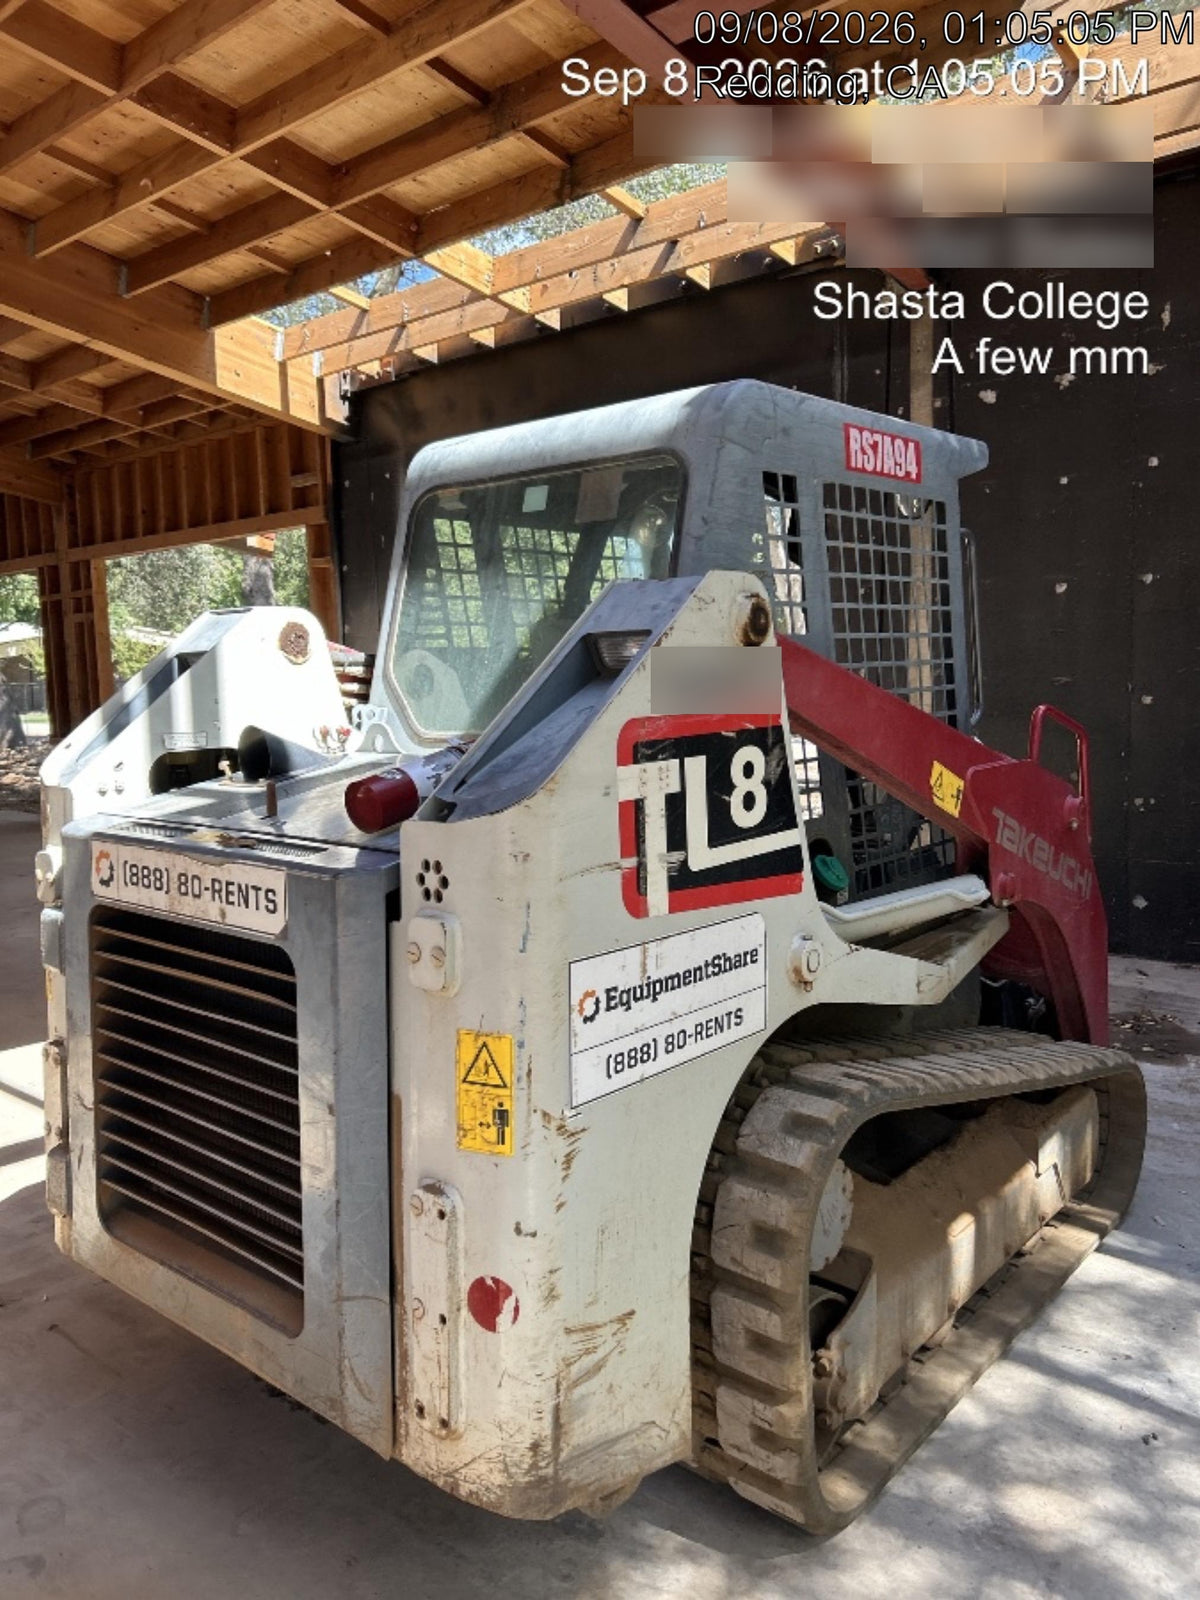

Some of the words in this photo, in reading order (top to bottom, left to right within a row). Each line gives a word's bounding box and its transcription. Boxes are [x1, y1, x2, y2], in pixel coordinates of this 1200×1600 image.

[849, 427, 919, 480] RS7A94
[123, 860, 170, 895] (888)
[177, 872, 278, 915] 80-RENTS
[604, 948, 760, 1012] EquipmentShare
[606, 1037, 659, 1080] (888)
[664, 1007, 744, 1055] 80-RENTS
